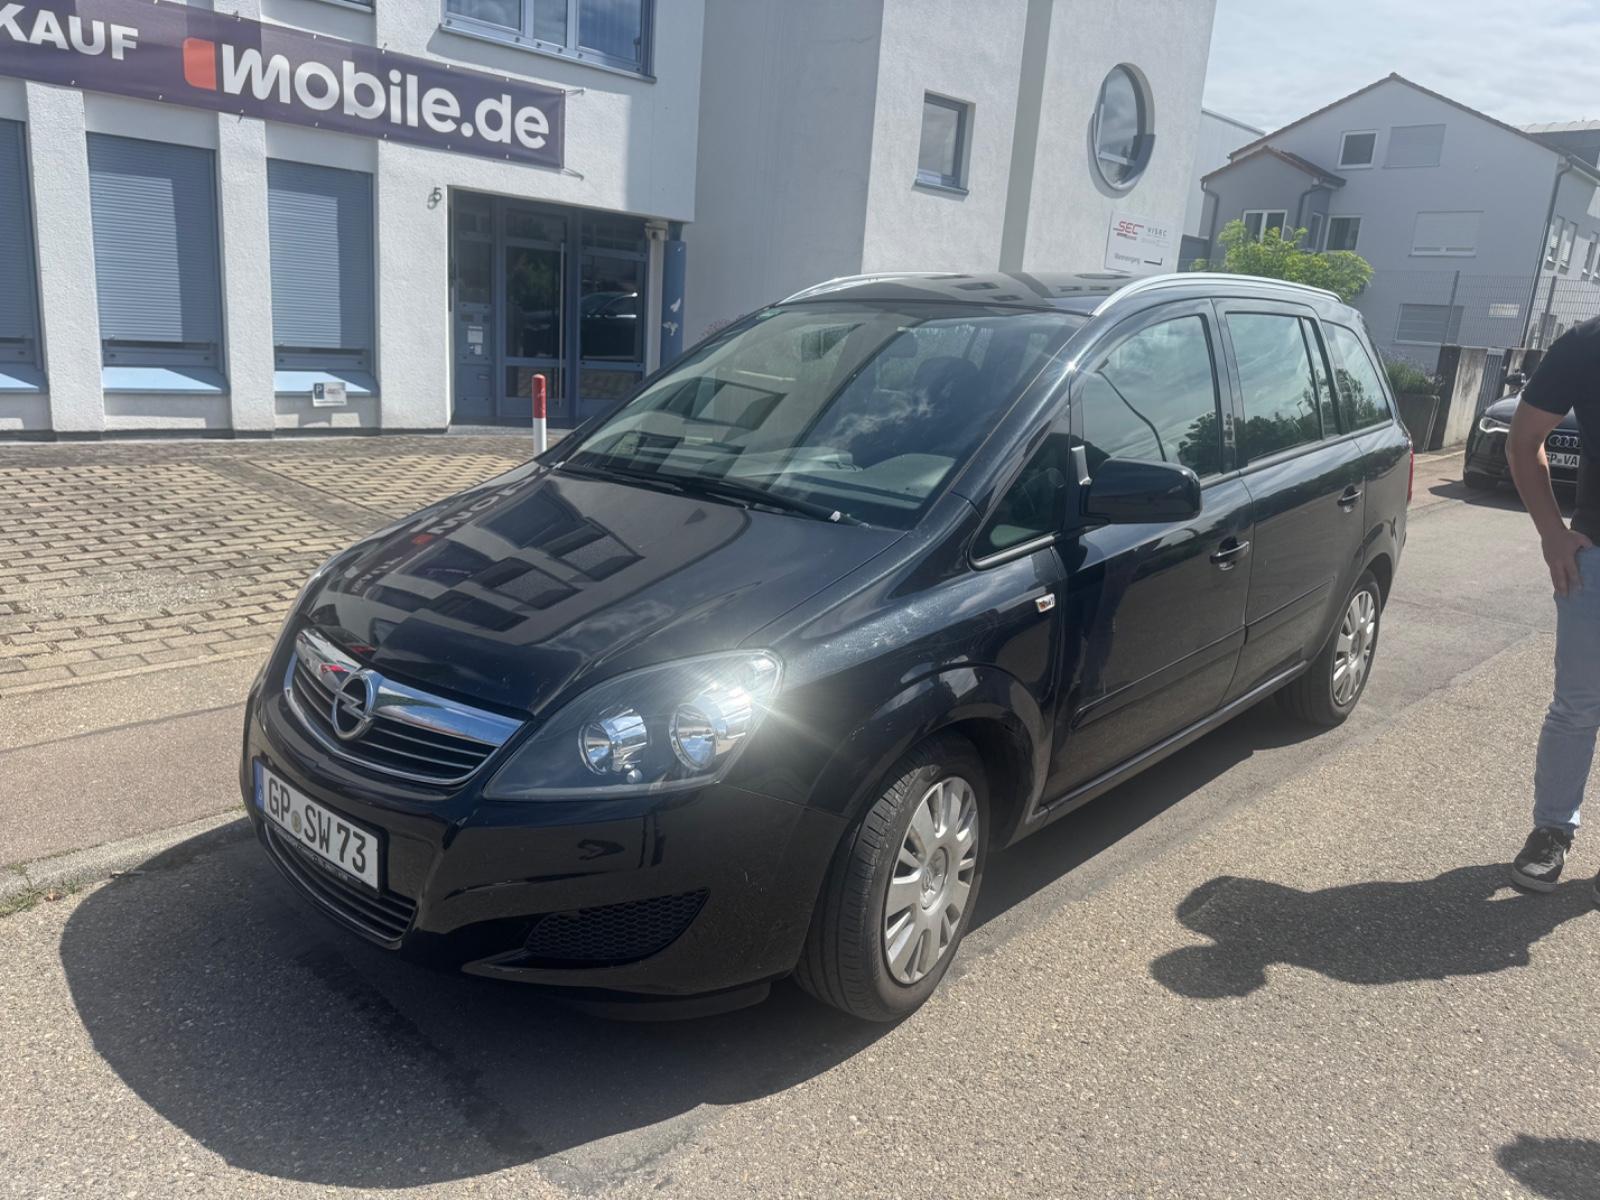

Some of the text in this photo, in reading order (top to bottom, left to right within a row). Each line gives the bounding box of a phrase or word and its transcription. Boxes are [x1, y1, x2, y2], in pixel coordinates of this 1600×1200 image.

[221, 44, 550, 149] mobile.de
[1114, 220, 1144, 235] SEC
[268, 777, 291, 822] GP
[304, 804, 331, 854] SW
[337, 822, 366, 874] 73
